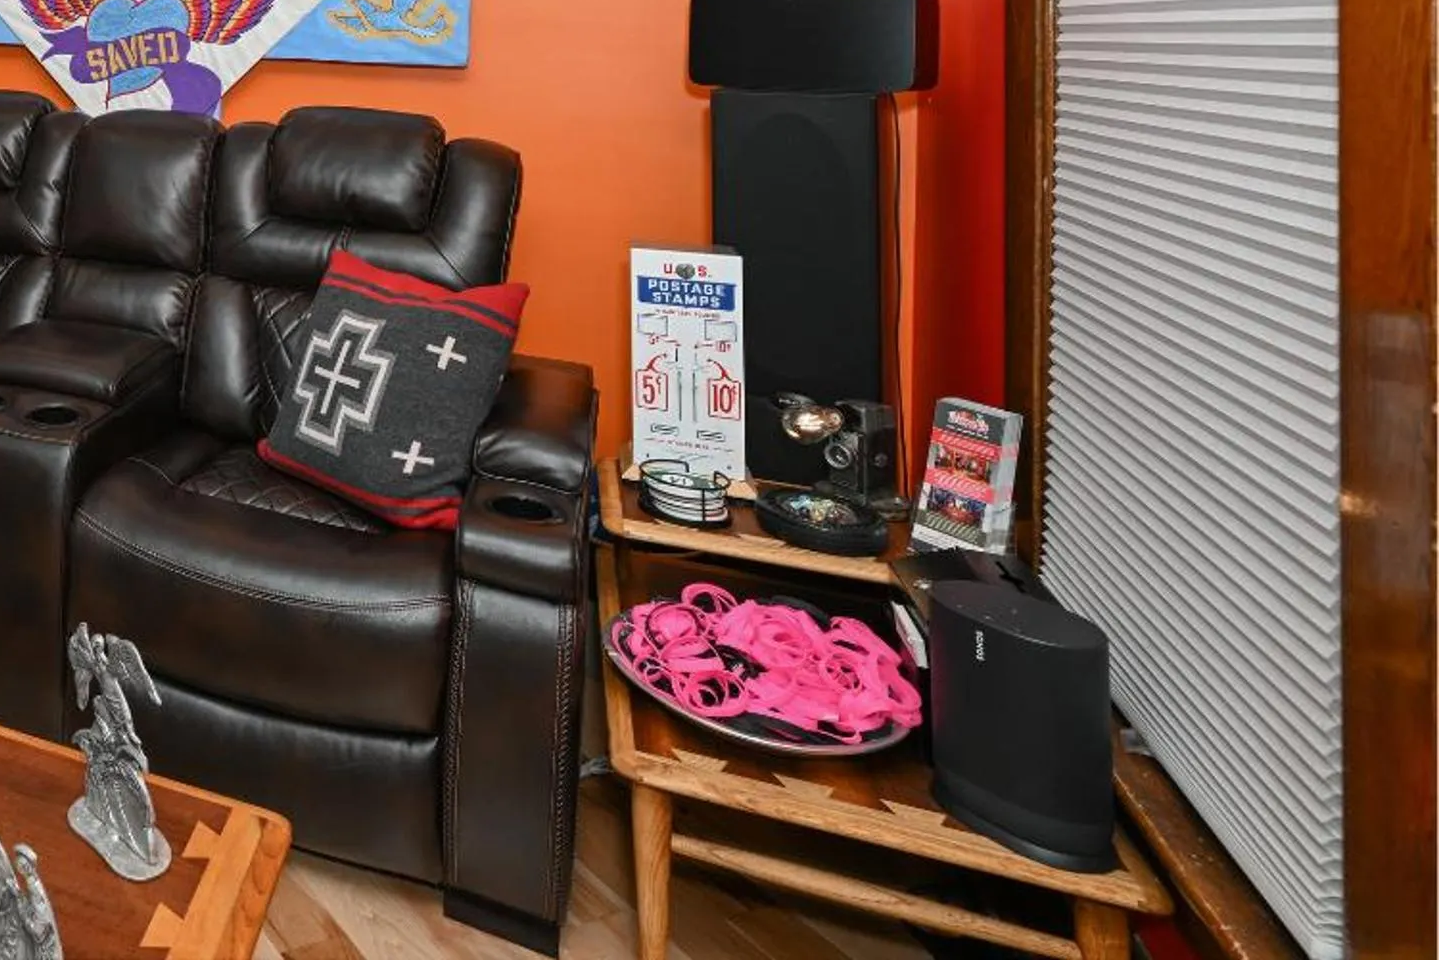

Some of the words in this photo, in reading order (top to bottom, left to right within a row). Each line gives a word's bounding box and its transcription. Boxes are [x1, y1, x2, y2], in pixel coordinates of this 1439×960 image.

[85, 30, 181, 81] SAVED
[647, 278, 726, 297] POSTAGE
[651, 291, 722, 309] STAMPS
